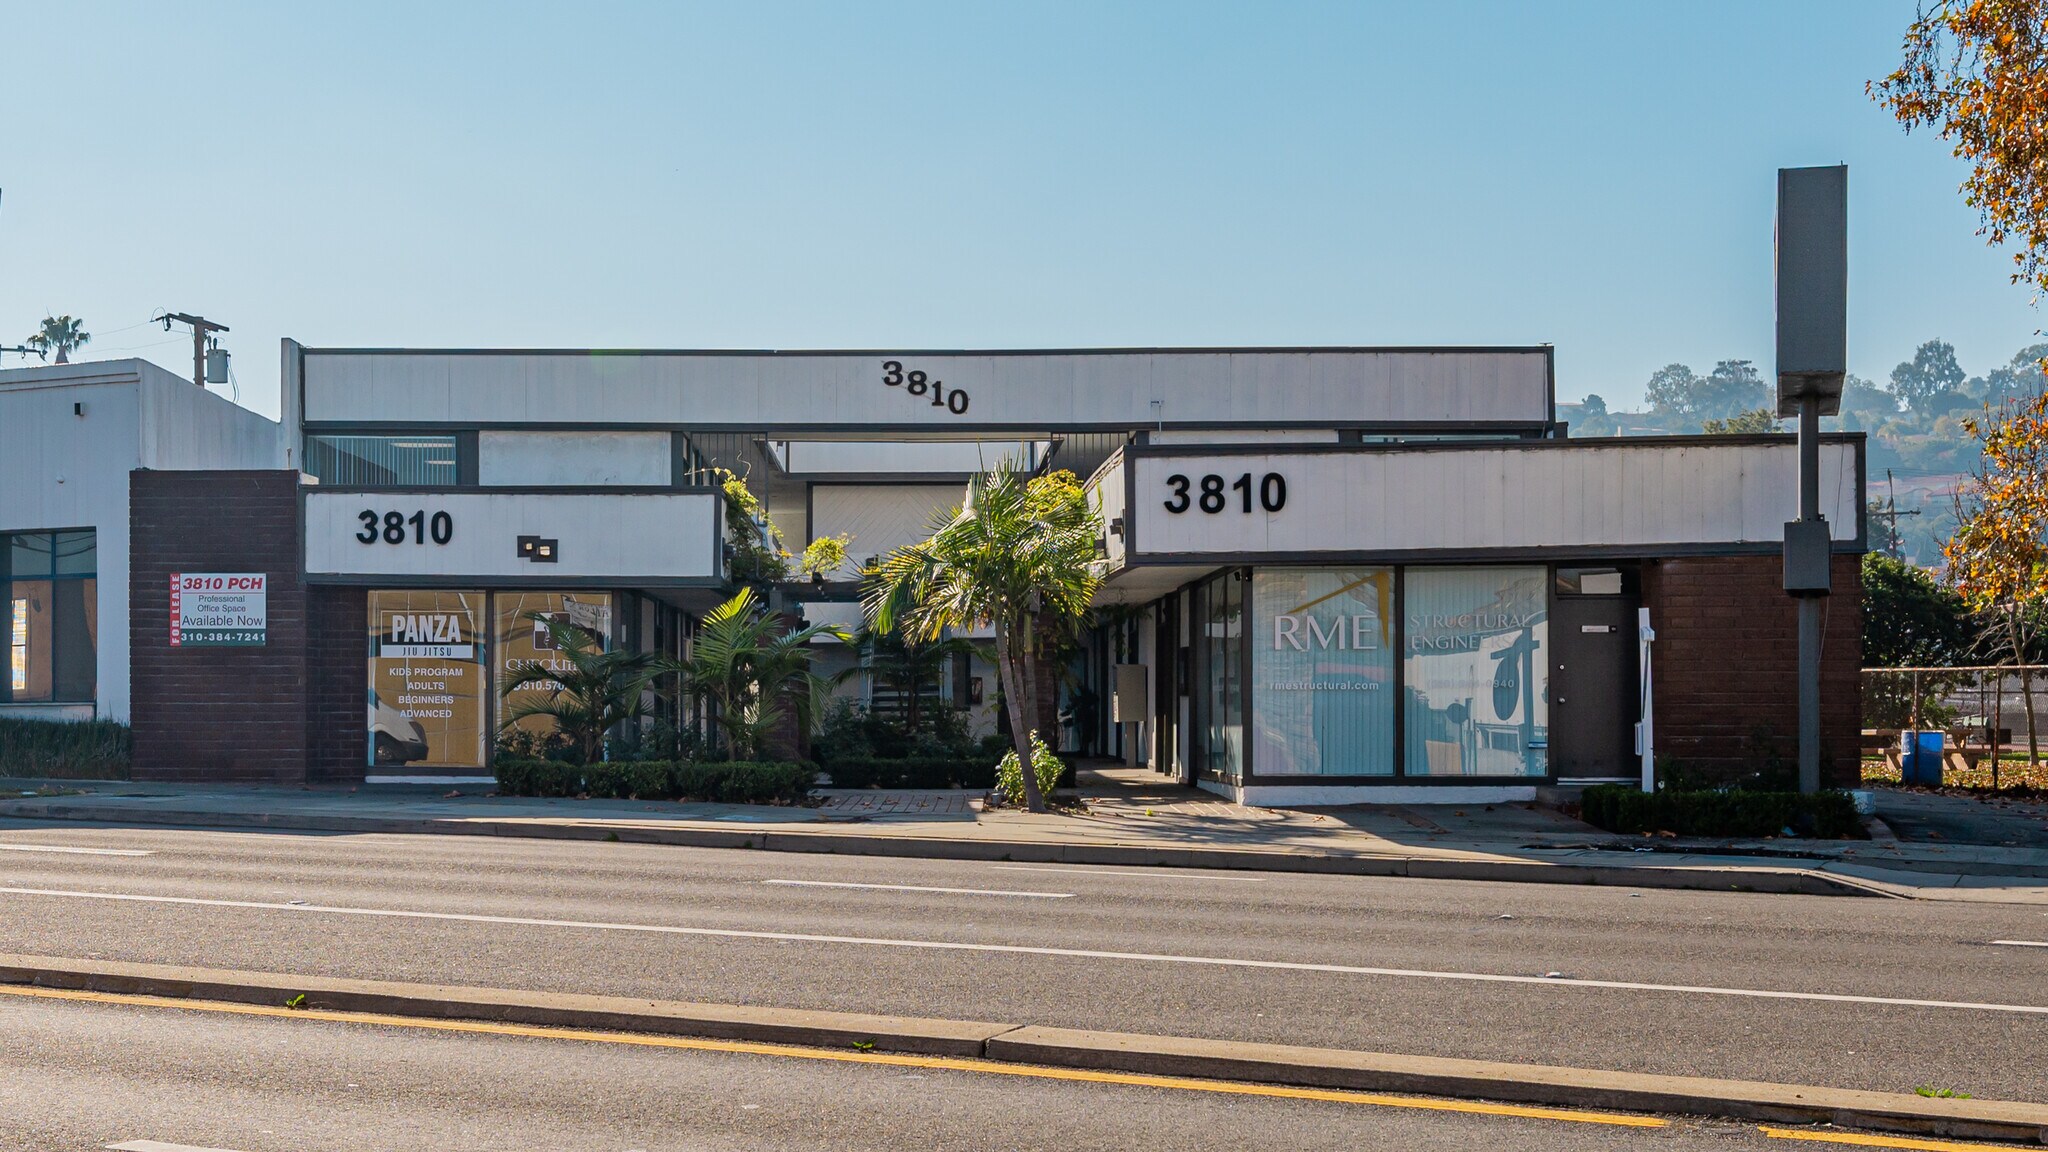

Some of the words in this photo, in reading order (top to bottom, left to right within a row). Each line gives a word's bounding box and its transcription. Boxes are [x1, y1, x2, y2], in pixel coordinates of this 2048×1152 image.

[882, 360, 969, 415] 3810
[1163, 472, 1287, 514] 3810
[356, 509, 453, 545] 3810
[183, 578, 223, 590] 3810
[227, 578, 263, 590] PCH
[171, 575, 180, 614] LEASE
[198, 595, 245, 603] Professional
[197, 604, 219, 613] Office
[222, 604, 246, 613] Space
[182, 615, 233, 626] Available
[237, 616, 263, 626] Now
[1410, 614, 1531, 628] STRUCTURAL
[171, 620, 180, 643] FOR
[392, 615, 461, 642] PANZA
[1274, 615, 1378, 650] RME
[181, 633, 266, 642] 310-384-7241
[1411, 635, 1513, 649] ENGINEERS
[402, 647, 418, 656] JIU
[423, 647, 452, 656] JITSU
[389, 668, 412, 676] KIDS
[414, 668, 463, 676] PROGRAM
[408, 682, 445, 690] ADULTS
[1270, 681, 1379, 691] rmestructural.com
[398, 696, 454, 704] BEGINNERS
[400, 710, 452, 718] ADVANCED
